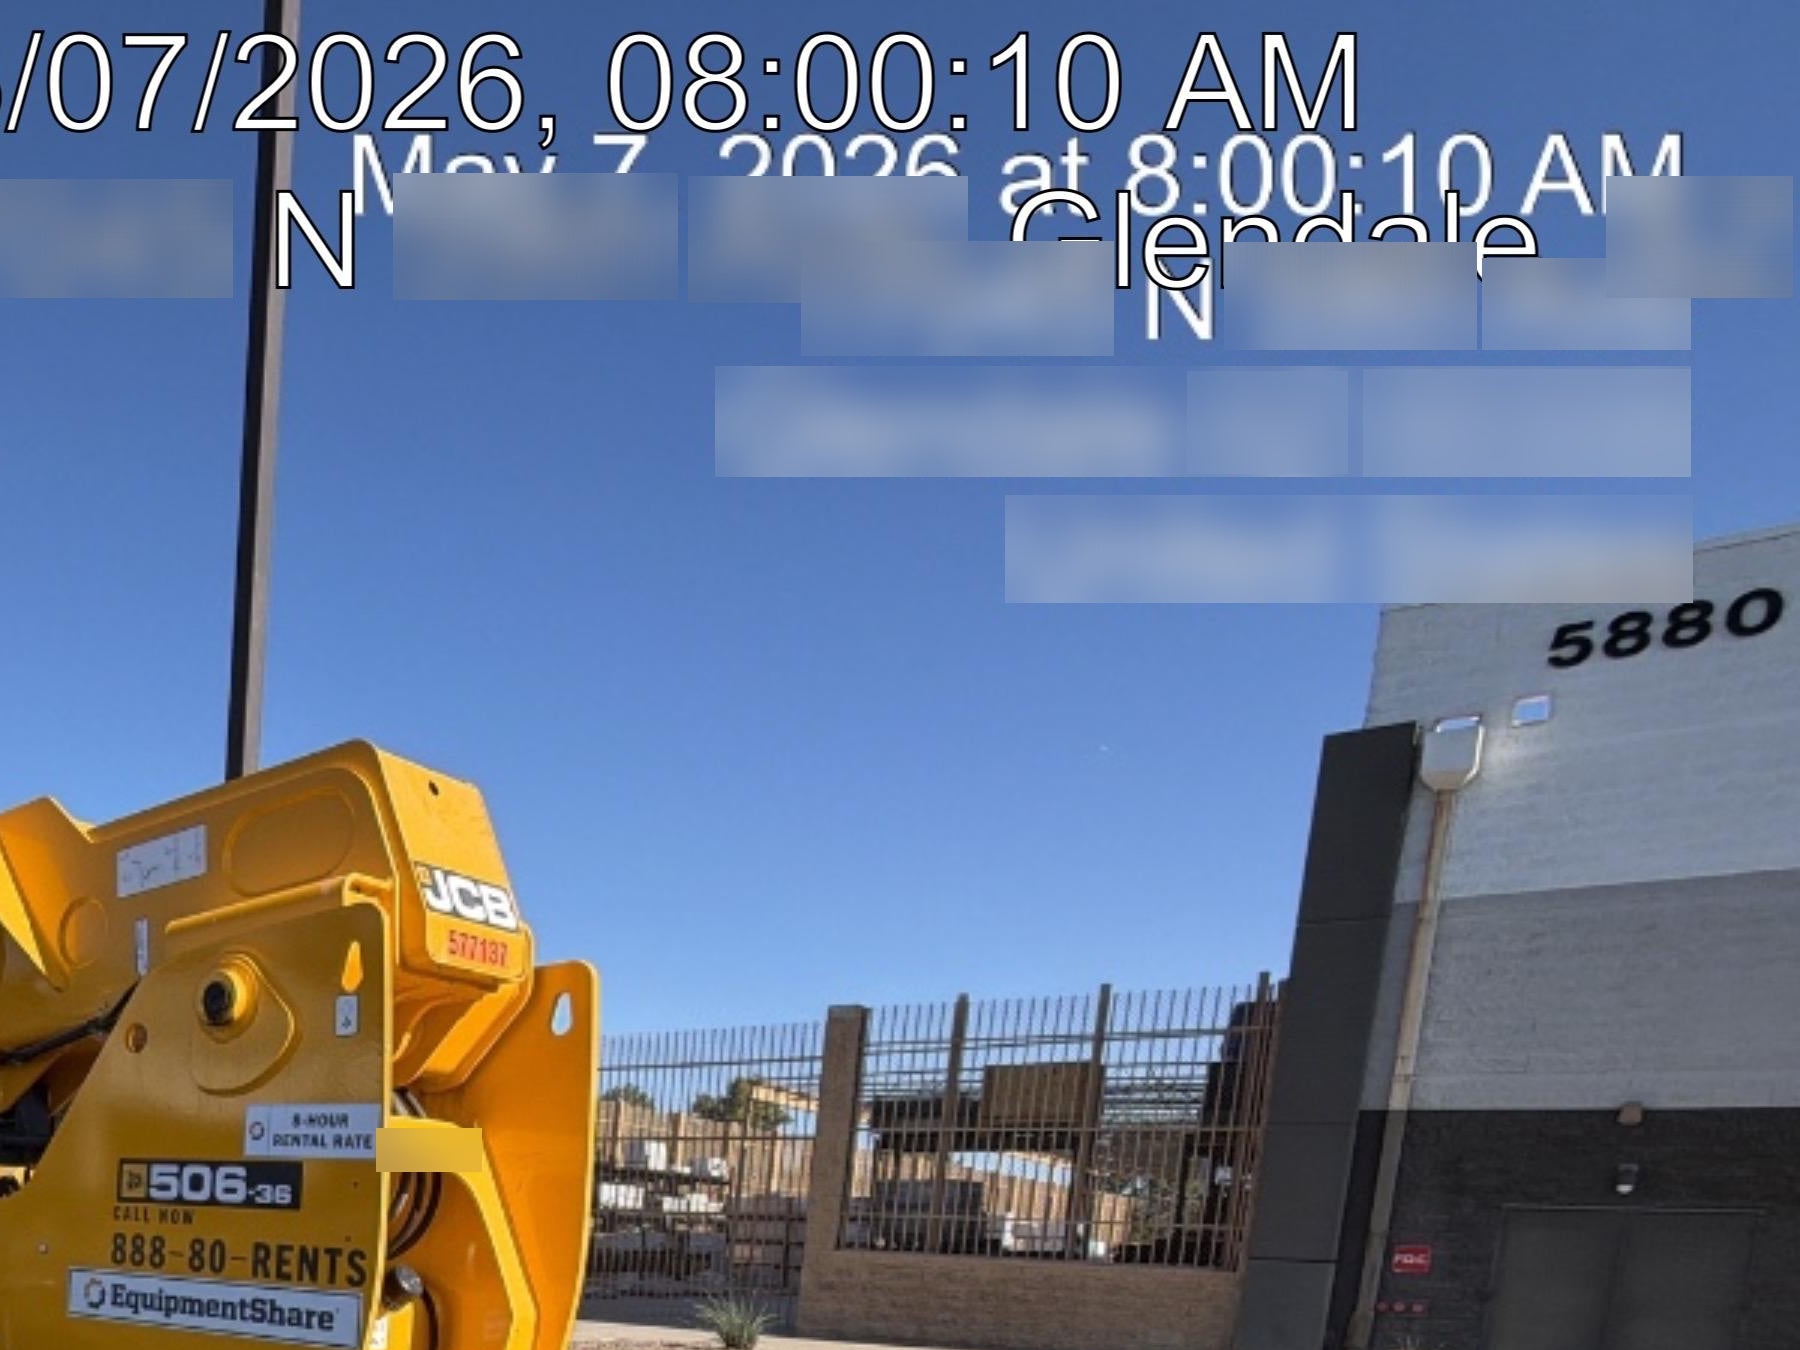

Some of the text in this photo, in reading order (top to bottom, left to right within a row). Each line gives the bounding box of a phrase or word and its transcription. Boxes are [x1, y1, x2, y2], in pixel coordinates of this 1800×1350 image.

[1547, 587, 1784, 669] 5880
[419, 868, 518, 931] JCB
[272, 1133, 373, 1151] RENTAL RATE
[112, 1205, 194, 1225] CALL NOW
[111, 1232, 368, 1288] 888-80-RENTS
[109, 1283, 335, 1332] EquipmentShare
